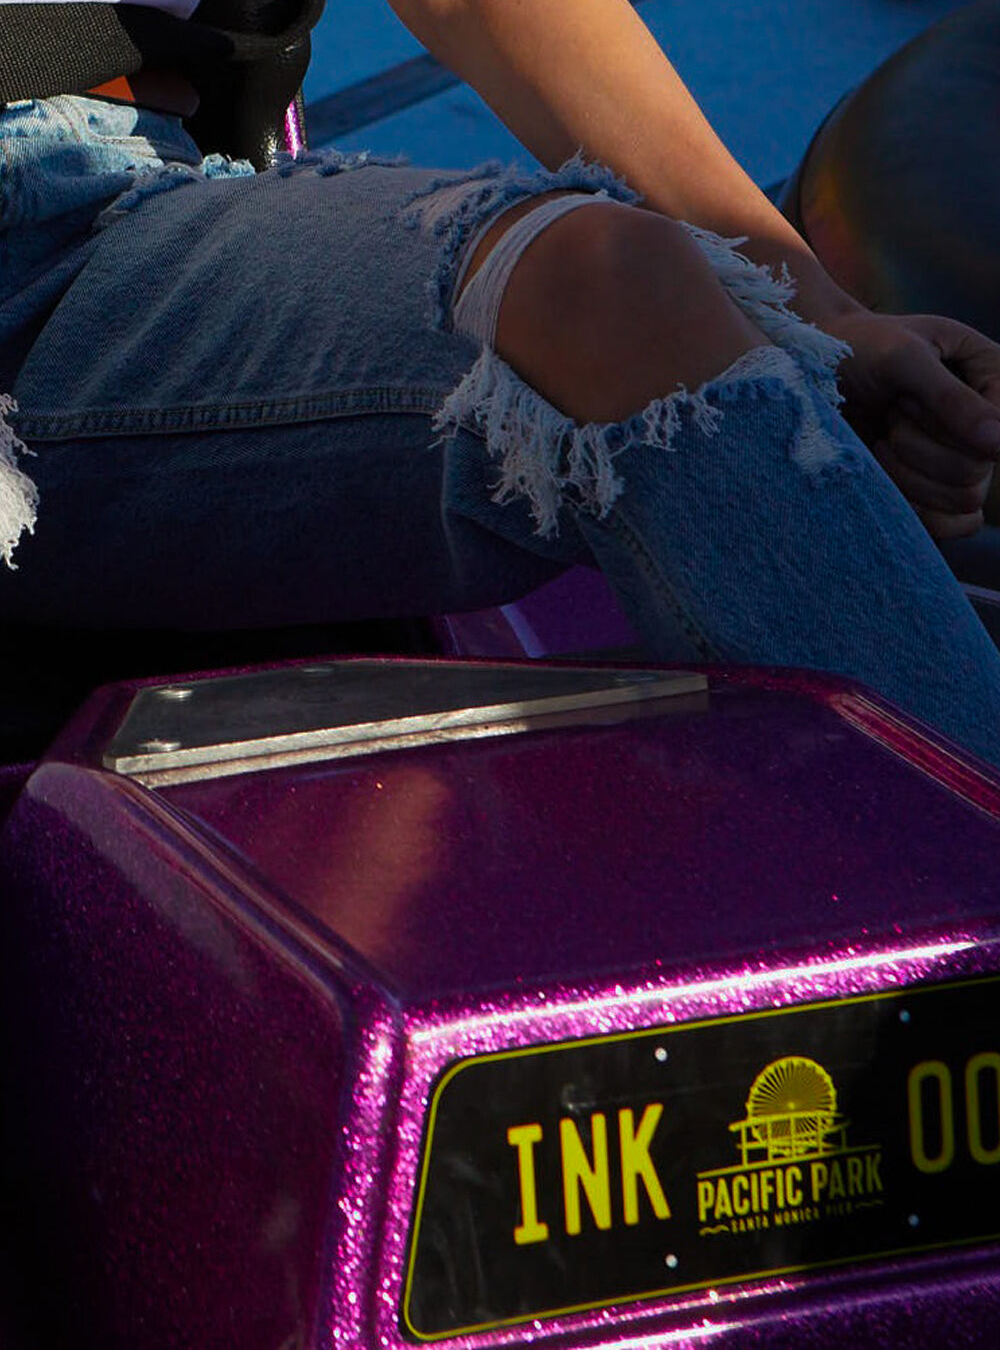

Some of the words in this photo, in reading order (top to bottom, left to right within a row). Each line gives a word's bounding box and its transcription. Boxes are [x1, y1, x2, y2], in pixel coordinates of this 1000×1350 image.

[507, 1103, 671, 1245] INK
[697, 1165, 804, 1223] PACIFIC
[810, 1152, 883, 1202] PARK
[731, 1215, 770, 1234] SANTA
[774, 1206, 820, 1226] MONICA
